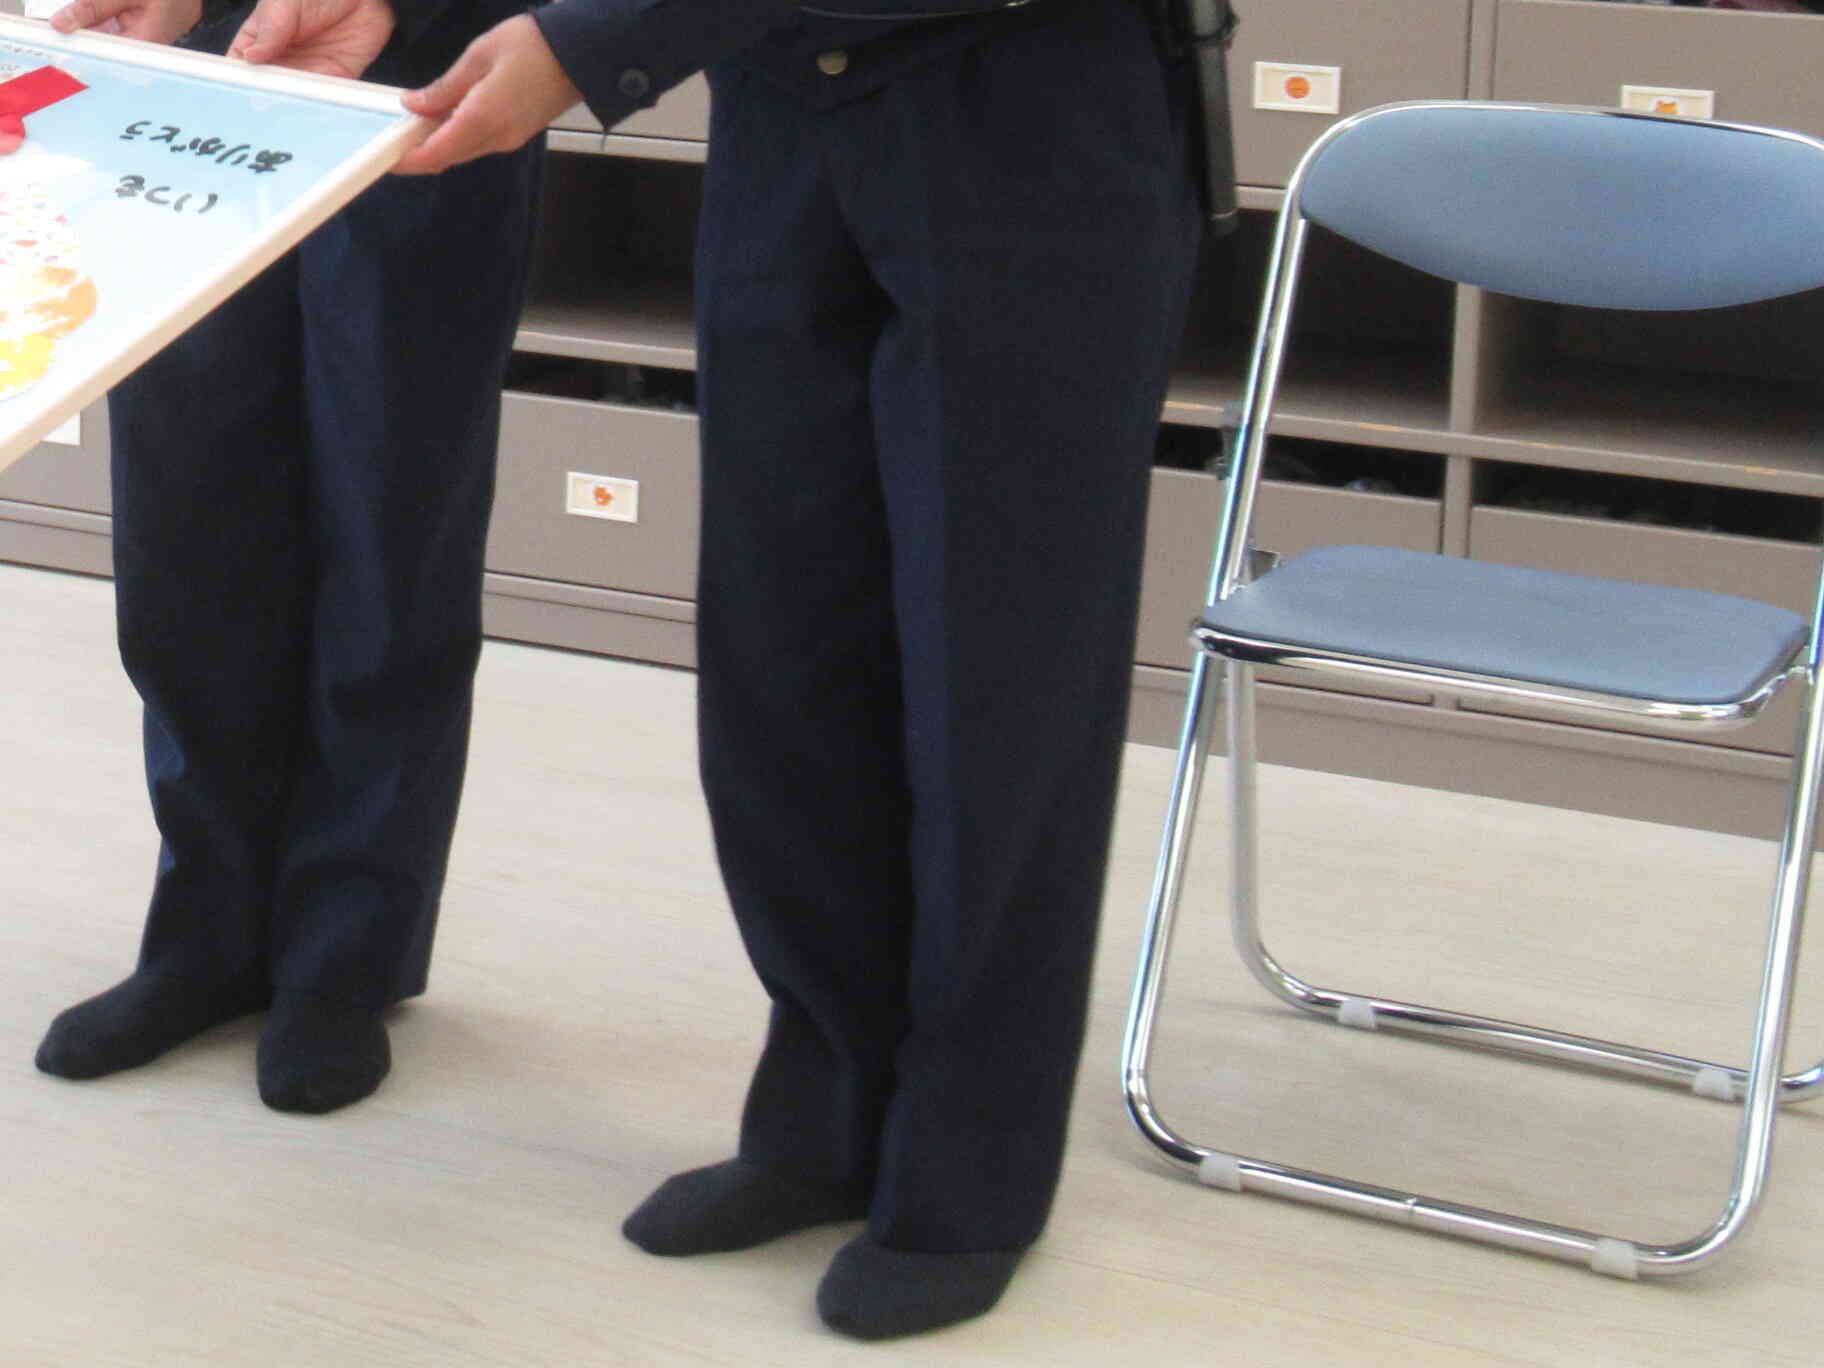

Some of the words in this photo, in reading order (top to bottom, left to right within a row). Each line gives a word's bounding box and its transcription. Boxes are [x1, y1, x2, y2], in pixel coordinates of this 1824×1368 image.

[119, 120, 294, 174] ありがとう
[114, 175, 219, 214] いつも
